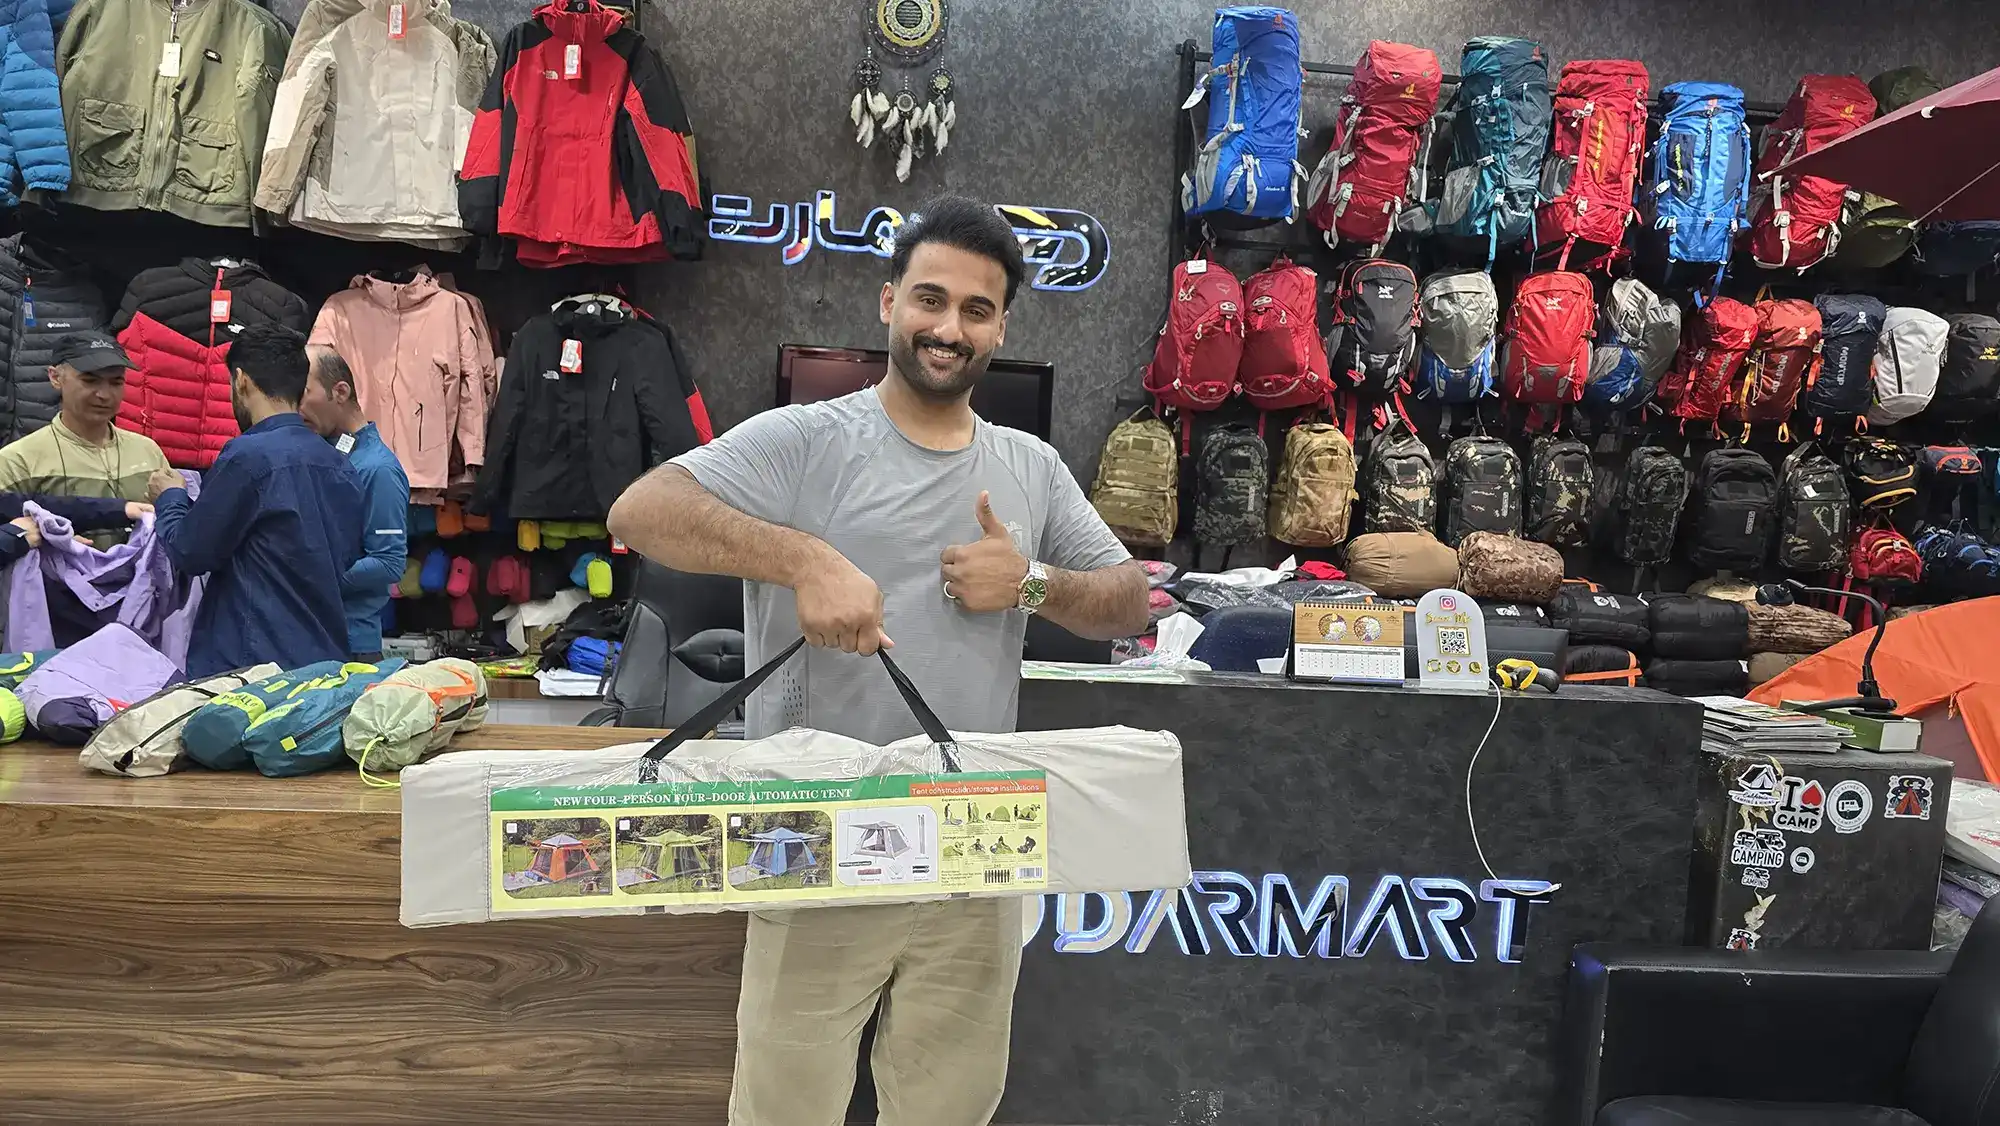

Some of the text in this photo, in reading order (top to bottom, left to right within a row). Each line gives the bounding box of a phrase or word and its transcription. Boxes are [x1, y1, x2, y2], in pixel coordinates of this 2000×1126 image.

[553, 796, 581, 807] NEW
[749, 789, 819, 801] AUTOMATIC
[820, 788, 853, 799] TENT
[1778, 814, 1818, 829] CAMP
[1733, 848, 1783, 867] CAMPING
[1022, 871, 1554, 963] DARMART
